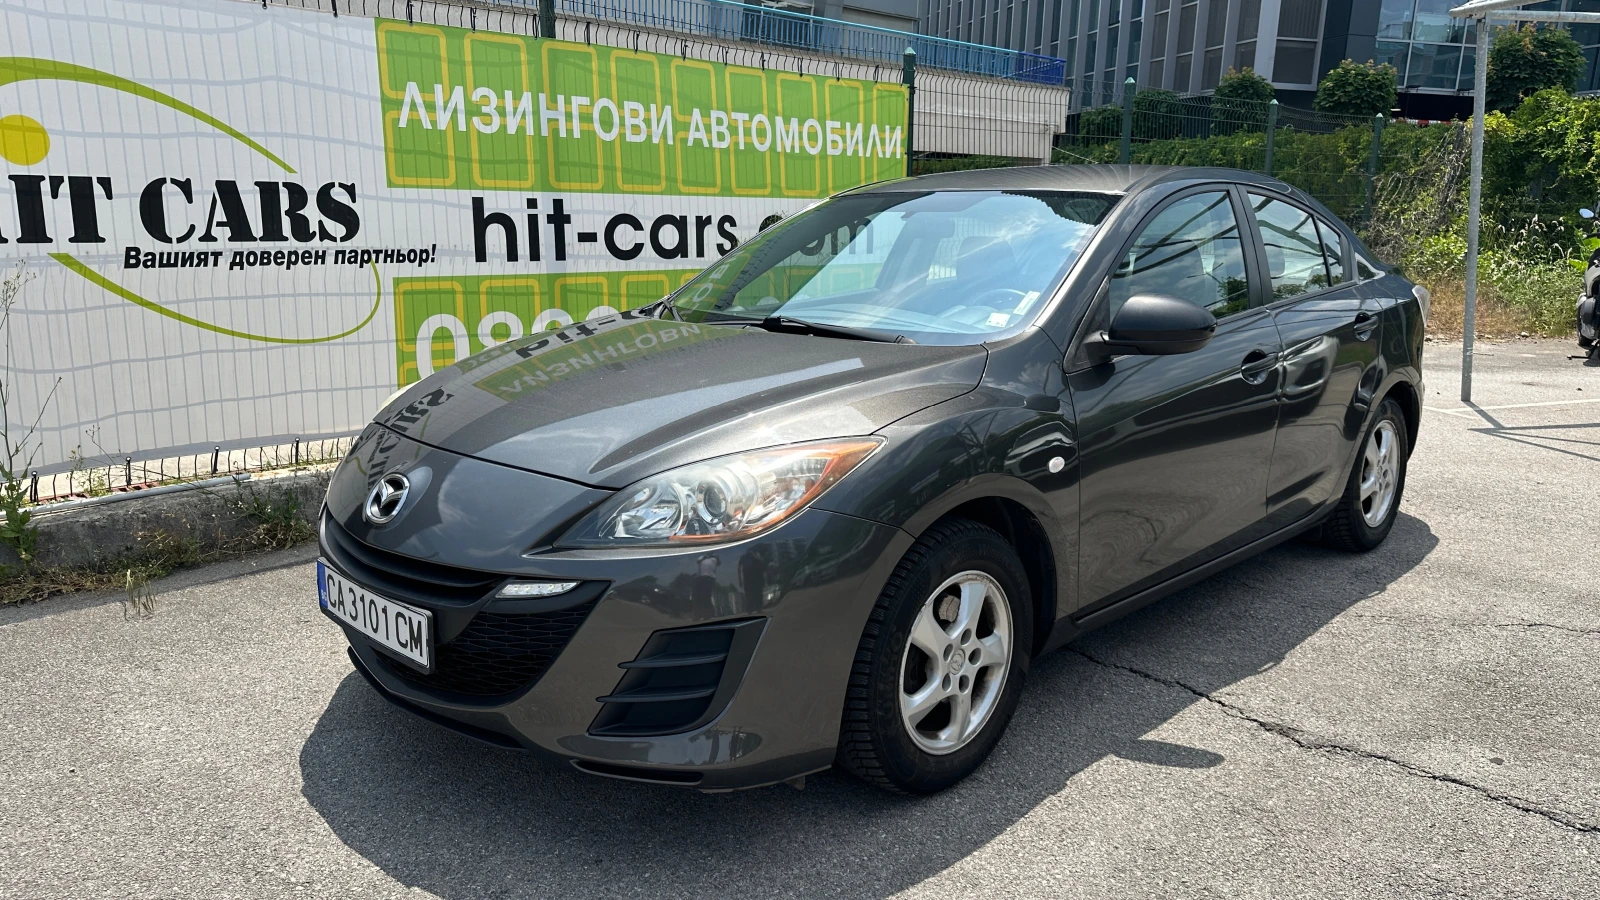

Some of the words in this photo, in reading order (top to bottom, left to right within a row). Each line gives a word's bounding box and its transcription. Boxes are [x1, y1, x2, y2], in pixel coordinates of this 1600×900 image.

[398, 81, 674, 146] ЛИЗИНГОВИ
[687, 107, 902, 159] АВТОМОБИЛИ
[0, 174, 114, 244] IT
[139, 176, 361, 245] CARS
[123, 247, 224, 269] Вашият
[229, 249, 327, 271] доверен
[333, 244, 437, 268] партньор!
[326, 573, 347, 616] CA
[348, 586, 390, 641] 3101
[394, 610, 424, 658] CM
